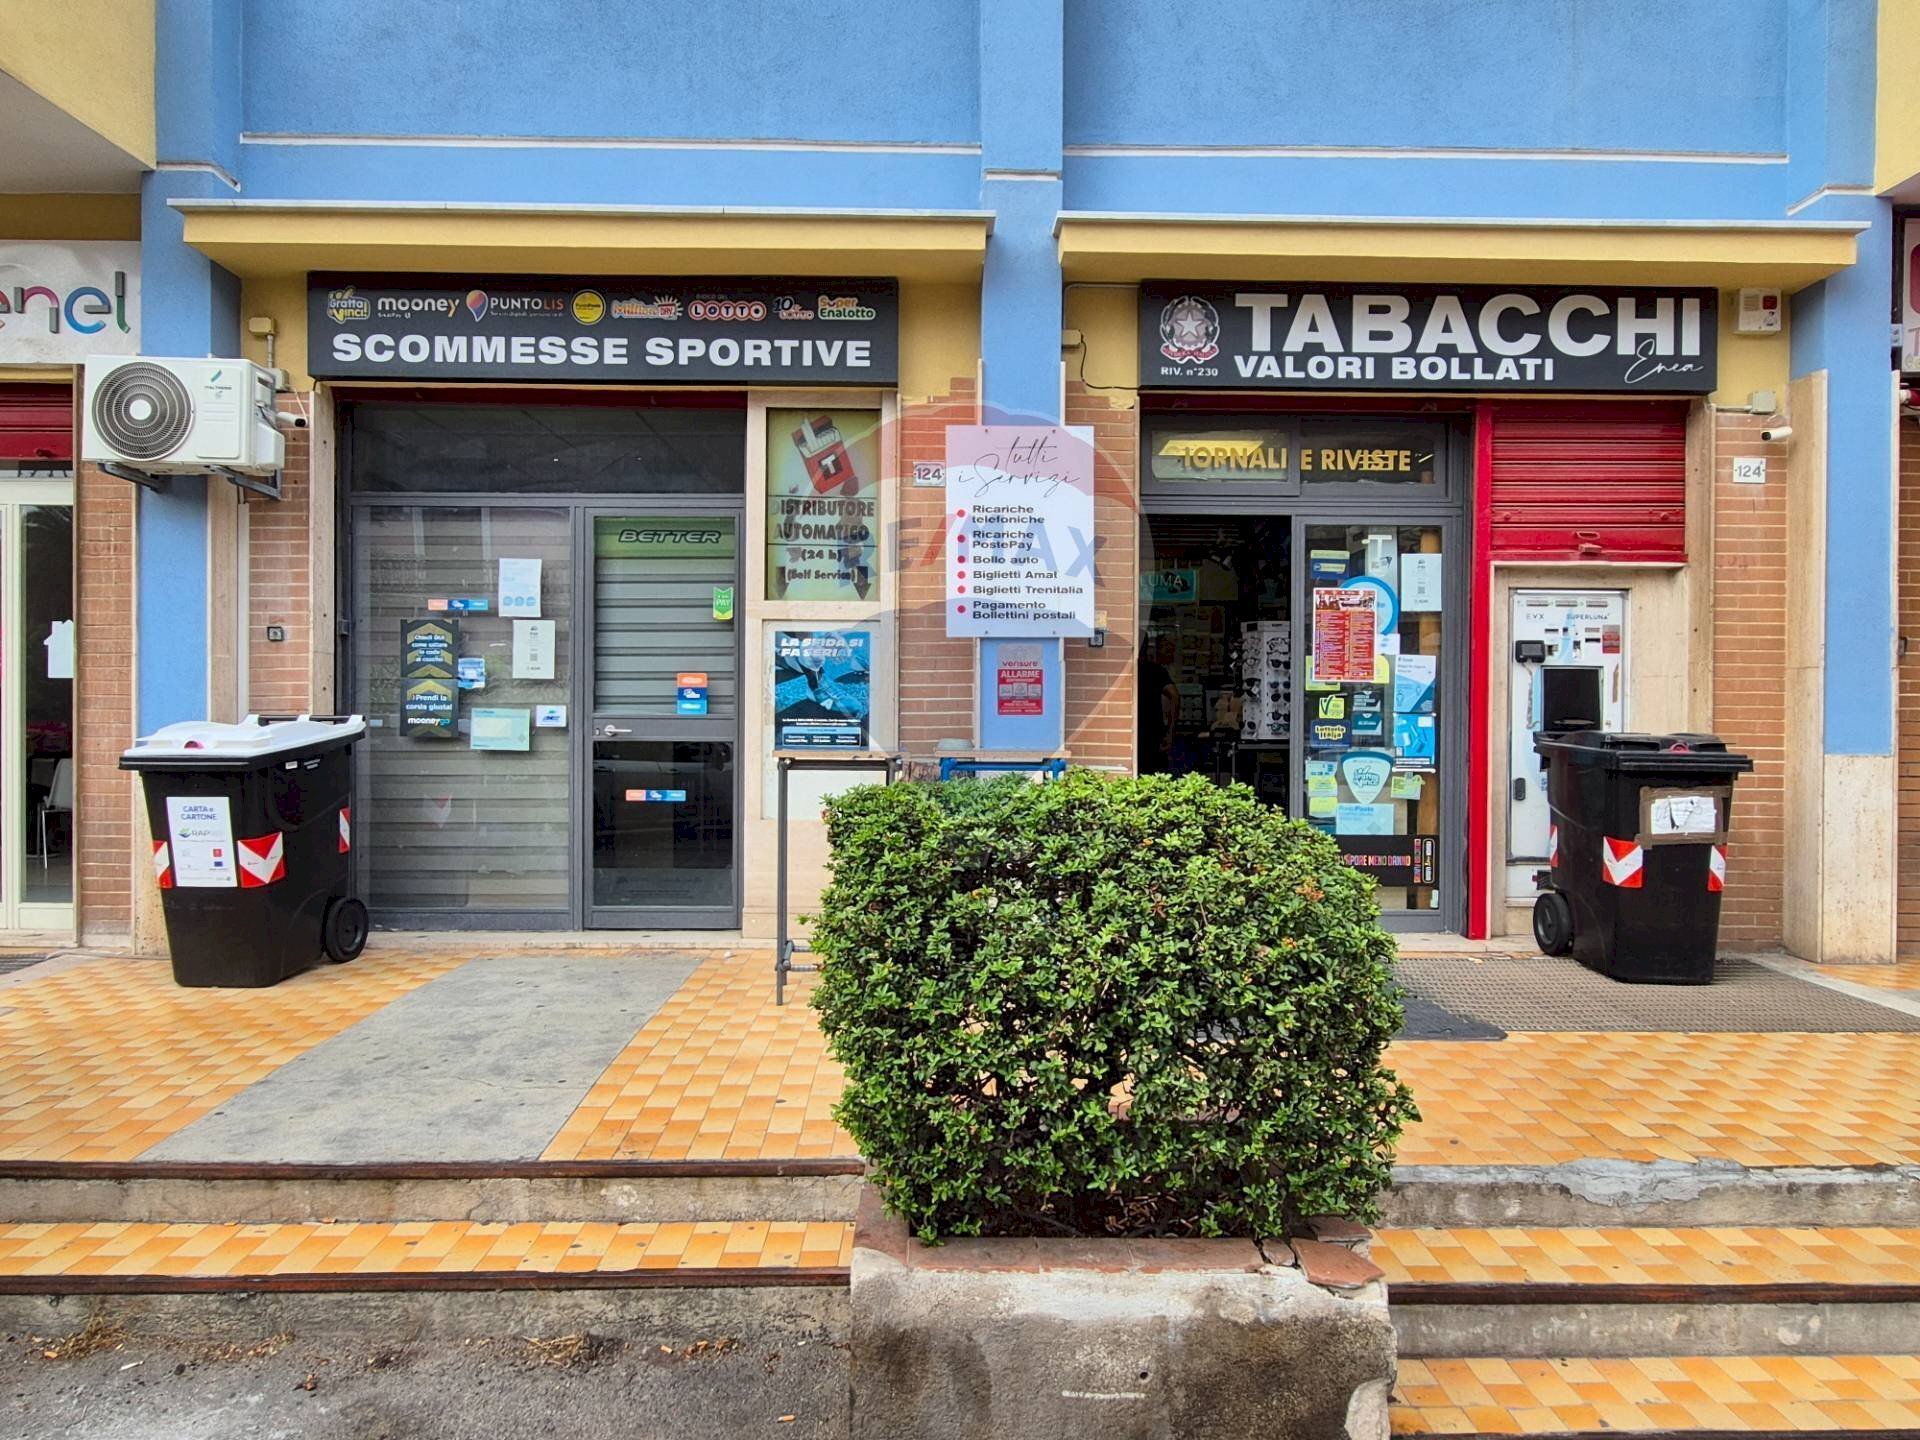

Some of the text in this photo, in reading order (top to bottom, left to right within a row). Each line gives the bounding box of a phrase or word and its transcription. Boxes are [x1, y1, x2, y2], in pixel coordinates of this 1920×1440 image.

[0, 271, 131, 334] nel
[377, 297, 460, 318] mooney
[490, 297, 565, 310] PUNTOLIS
[773, 297, 794, 311] 10
[693, 304, 762, 317] LOTTO
[820, 307, 874, 319] Enalotto
[1235, 293, 1701, 358] TABACCHI
[332, 333, 871, 367] SCOMMESSE SPORTIVE
[1624, 339, 1704, 384] Enea
[1160, 366, 1183, 376] RIV.
[1234, 355, 1554, 381] VALORI BOLLATI
[996, 436, 1058, 472] tutti
[1168, 447, 1411, 471] IORNALI E RIVISTE
[916, 467, 942, 481] 124
[972, 504, 1034, 514] Ricariche
[972, 515, 1045, 525] telefoniche
[619, 529, 721, 543] BETTER
[972, 530, 1035, 540] Ricariche
[972, 541, 1033, 551] PostePay
[972, 555, 1039, 564] Bollo auto
[972, 570, 1021, 580] Biglietti
[972, 585, 1084, 595] Biglietti Trenitalia
[972, 601, 1046, 611] Pagamento
[972, 610, 1076, 621] Bollettini postali
[780, 638, 864, 647] LA SFIDA SI
[780, 648, 801, 657] FA
[1000, 670, 1041, 678] ALLARME
[182, 805, 208, 813] CARTA
[180, 813, 217, 821] CARTONE
